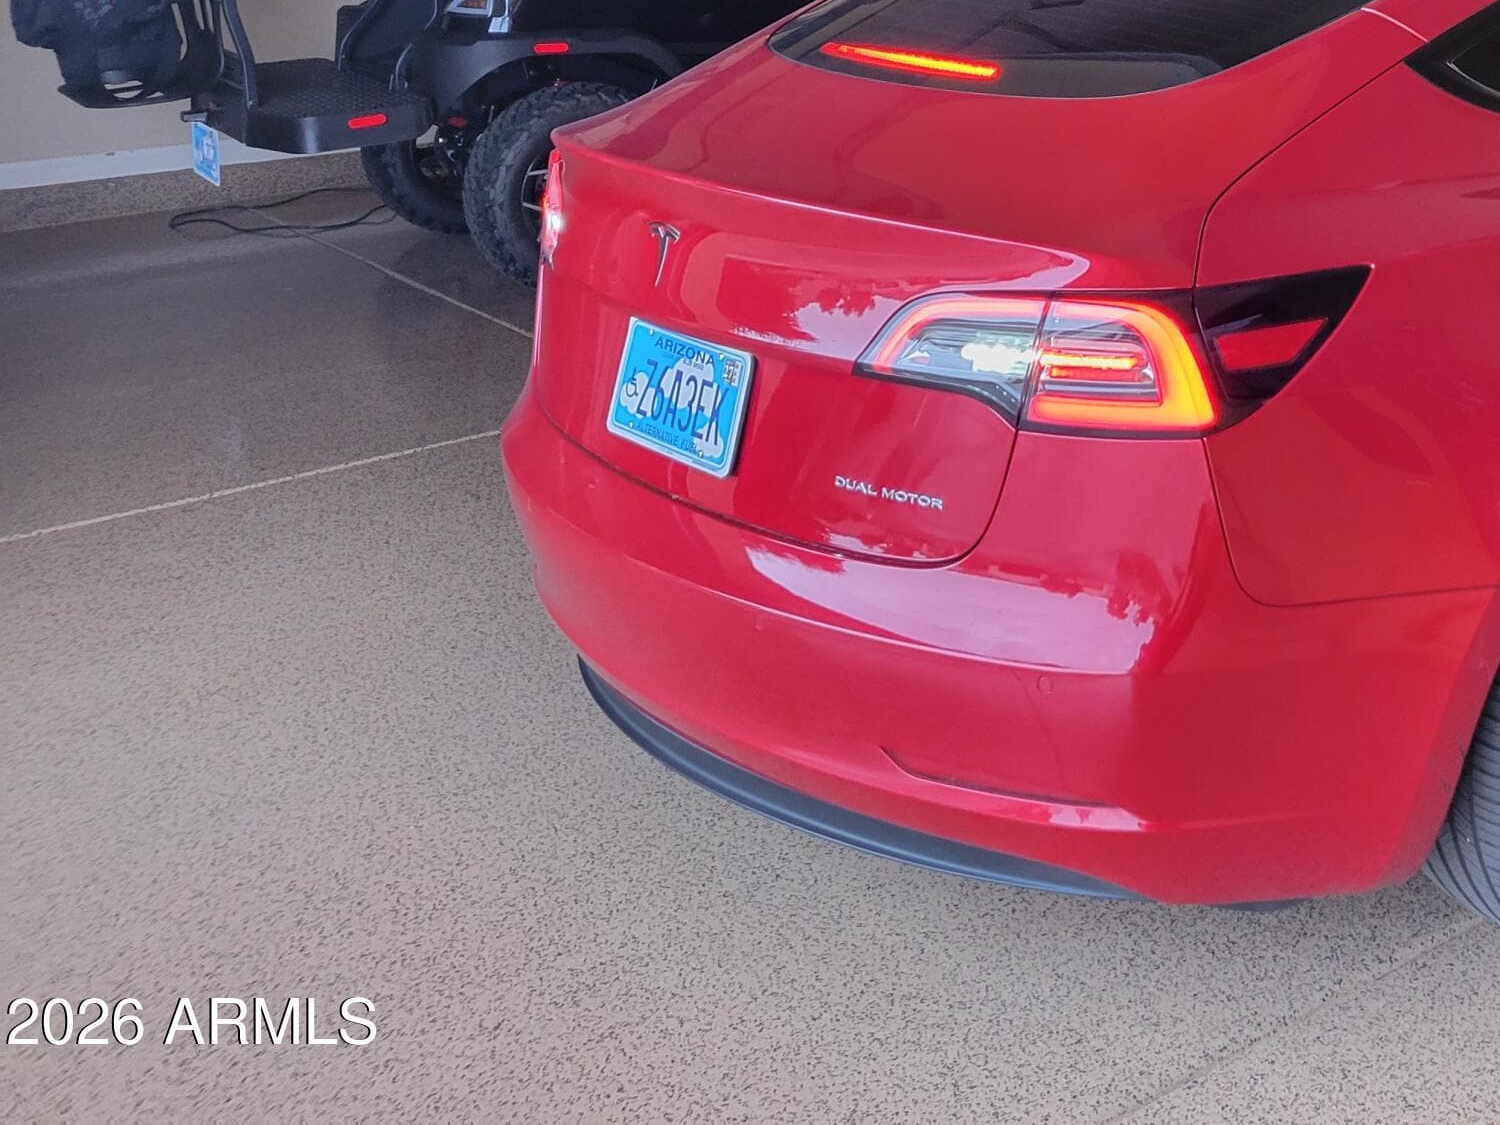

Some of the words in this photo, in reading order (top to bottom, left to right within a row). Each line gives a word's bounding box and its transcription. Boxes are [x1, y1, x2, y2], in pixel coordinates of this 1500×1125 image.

[654, 336, 716, 367] ARIZONA
[635, 358, 730, 446] Z6A3EK
[635, 423, 679, 448] ALTERNATIVE
[680, 439, 699, 454] FUEL
[834, 475, 878, 497] DUAL
[881, 487, 944, 511] MOTOR
